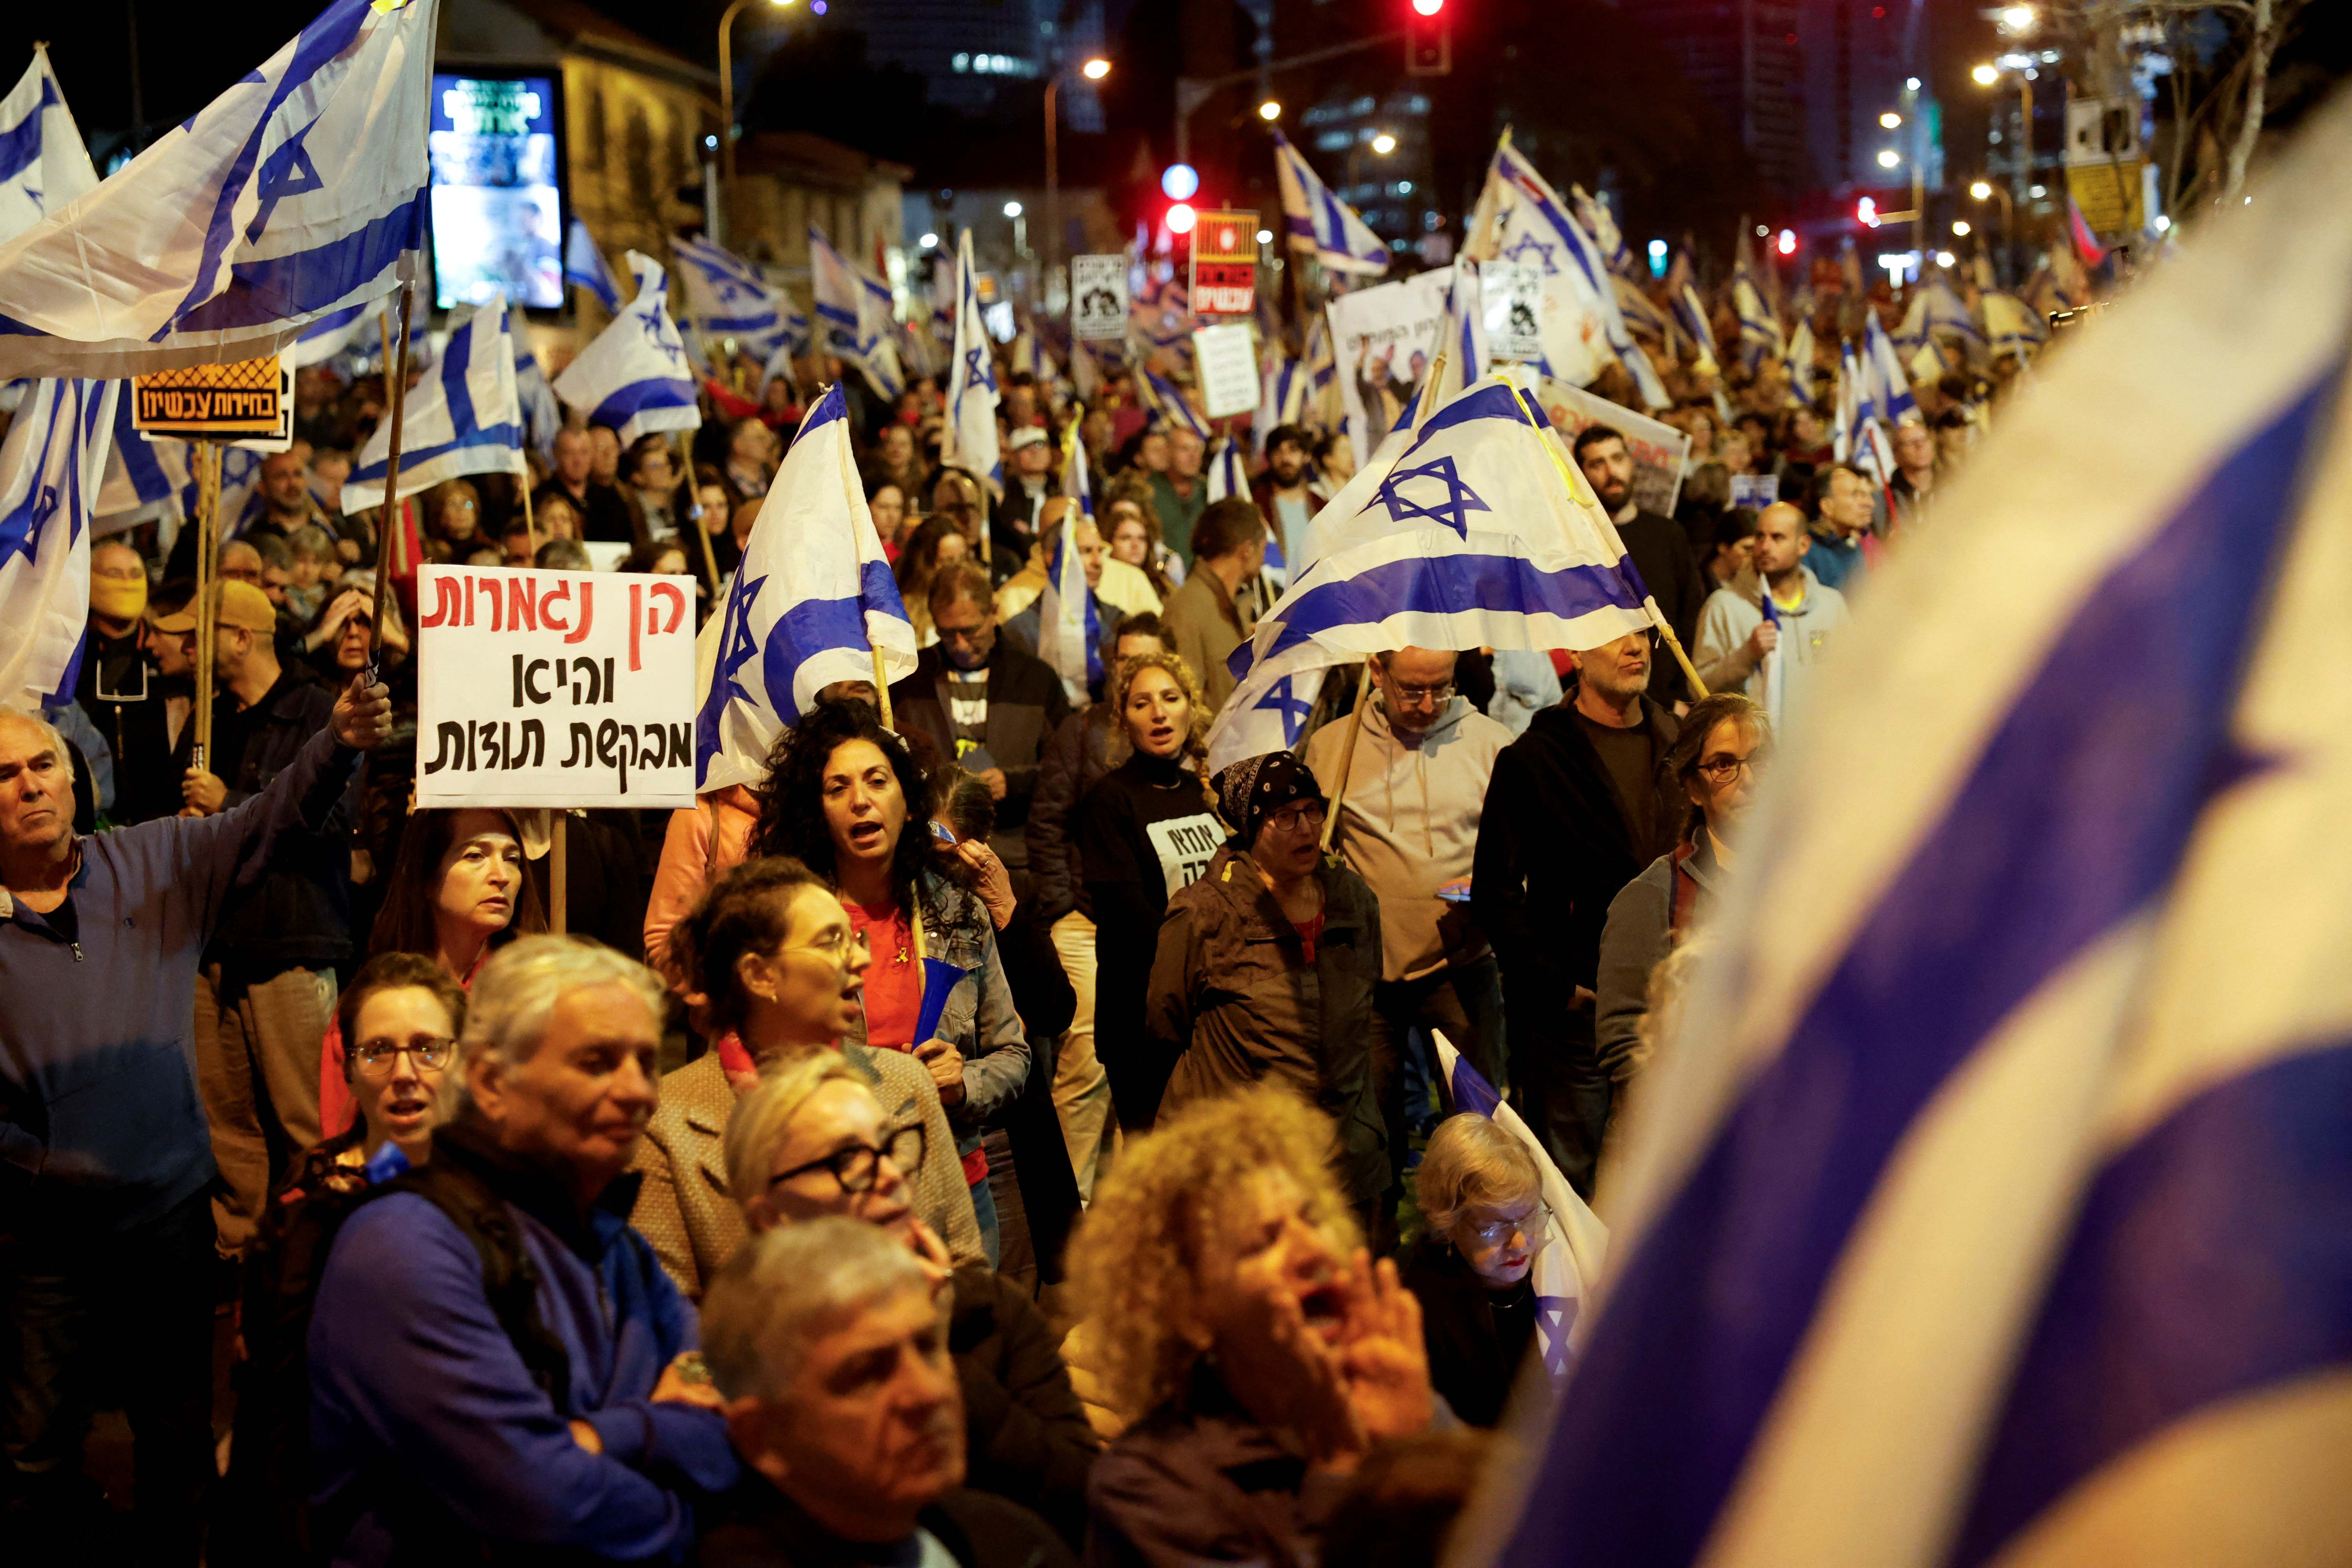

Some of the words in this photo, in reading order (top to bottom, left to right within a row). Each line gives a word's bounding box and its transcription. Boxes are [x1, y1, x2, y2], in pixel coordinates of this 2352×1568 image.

[143, 390, 212, 419] עכשיו!
[214, 392, 274, 417] בחירות
[421, 575, 593, 644] נגמרות
[629, 582, 686, 672] הן
[512, 654, 615, 708] והיא
[561, 718, 692, 795] מבקשת
[1167, 824, 1219, 856] אמא
